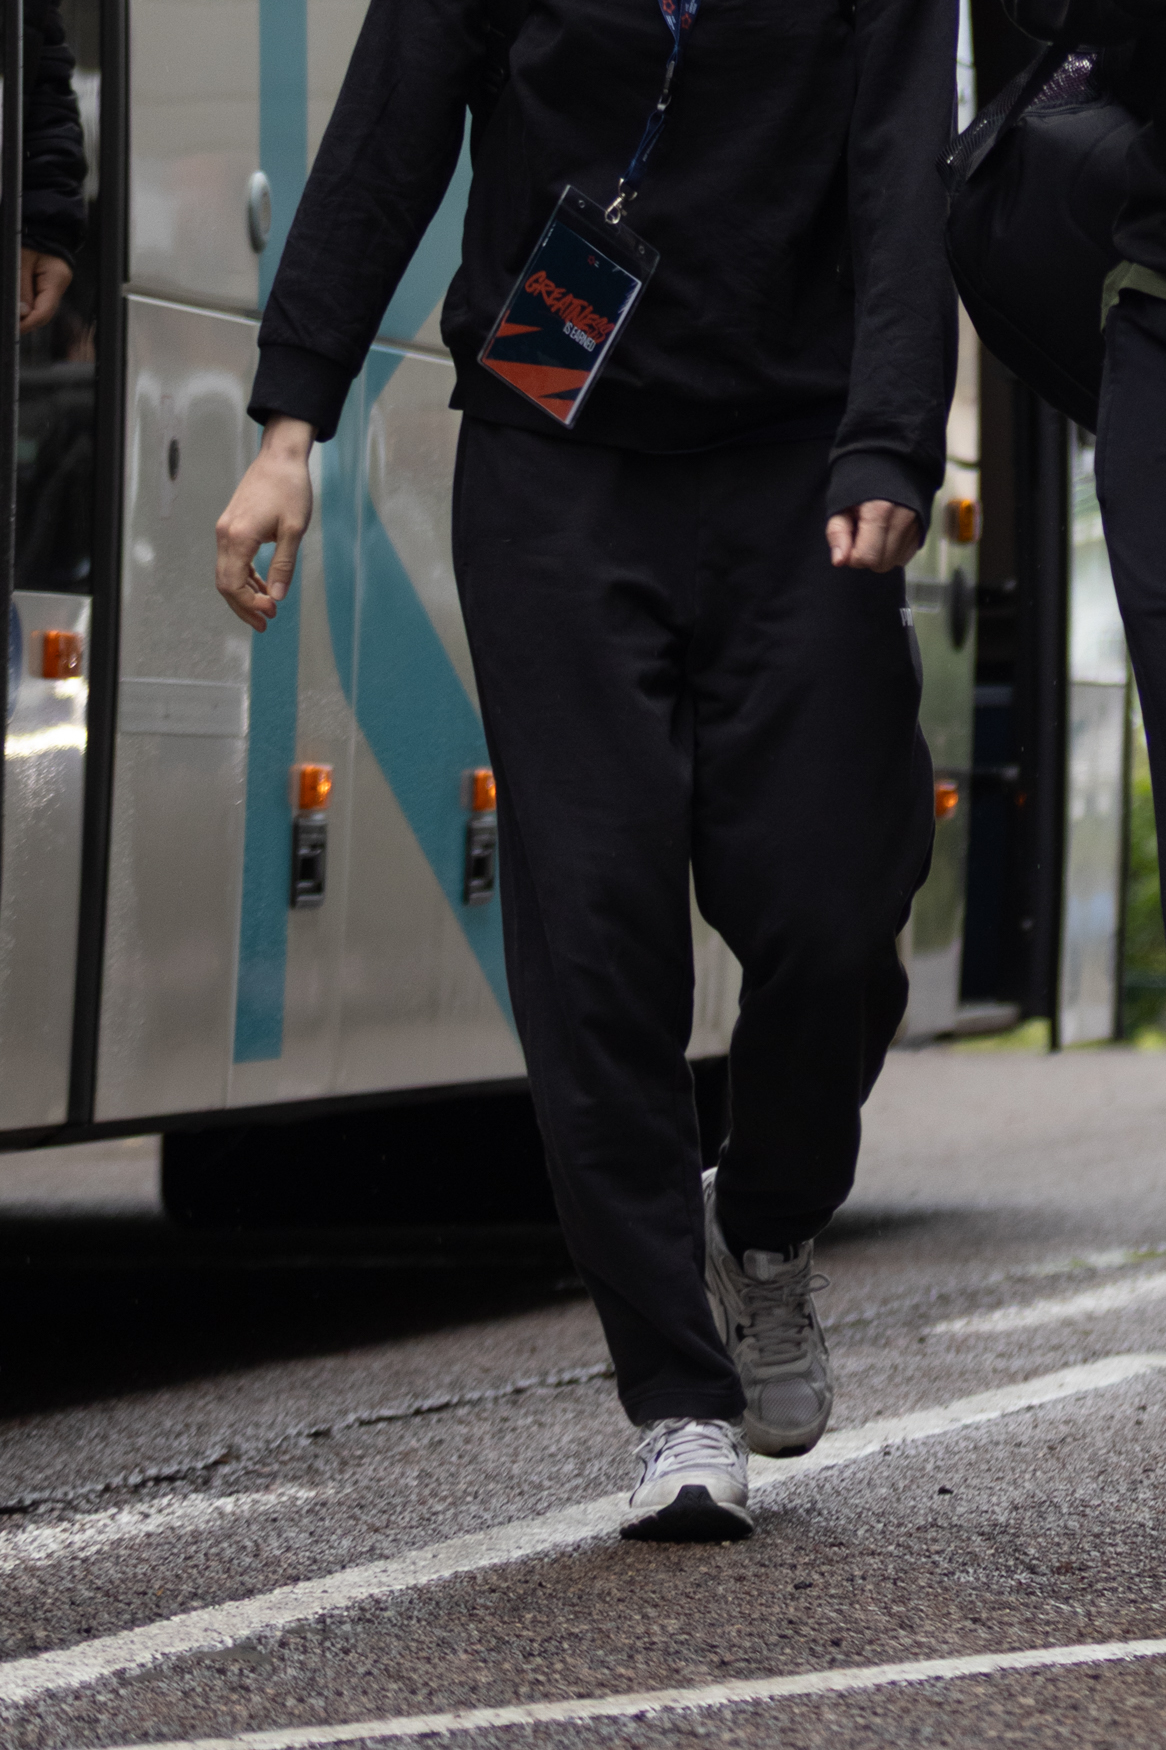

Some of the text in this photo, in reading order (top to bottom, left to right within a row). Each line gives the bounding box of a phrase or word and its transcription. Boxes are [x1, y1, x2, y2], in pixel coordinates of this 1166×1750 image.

[525, 270, 614, 344] GREATNESS
[563, 321, 597, 352] IS EARNED
